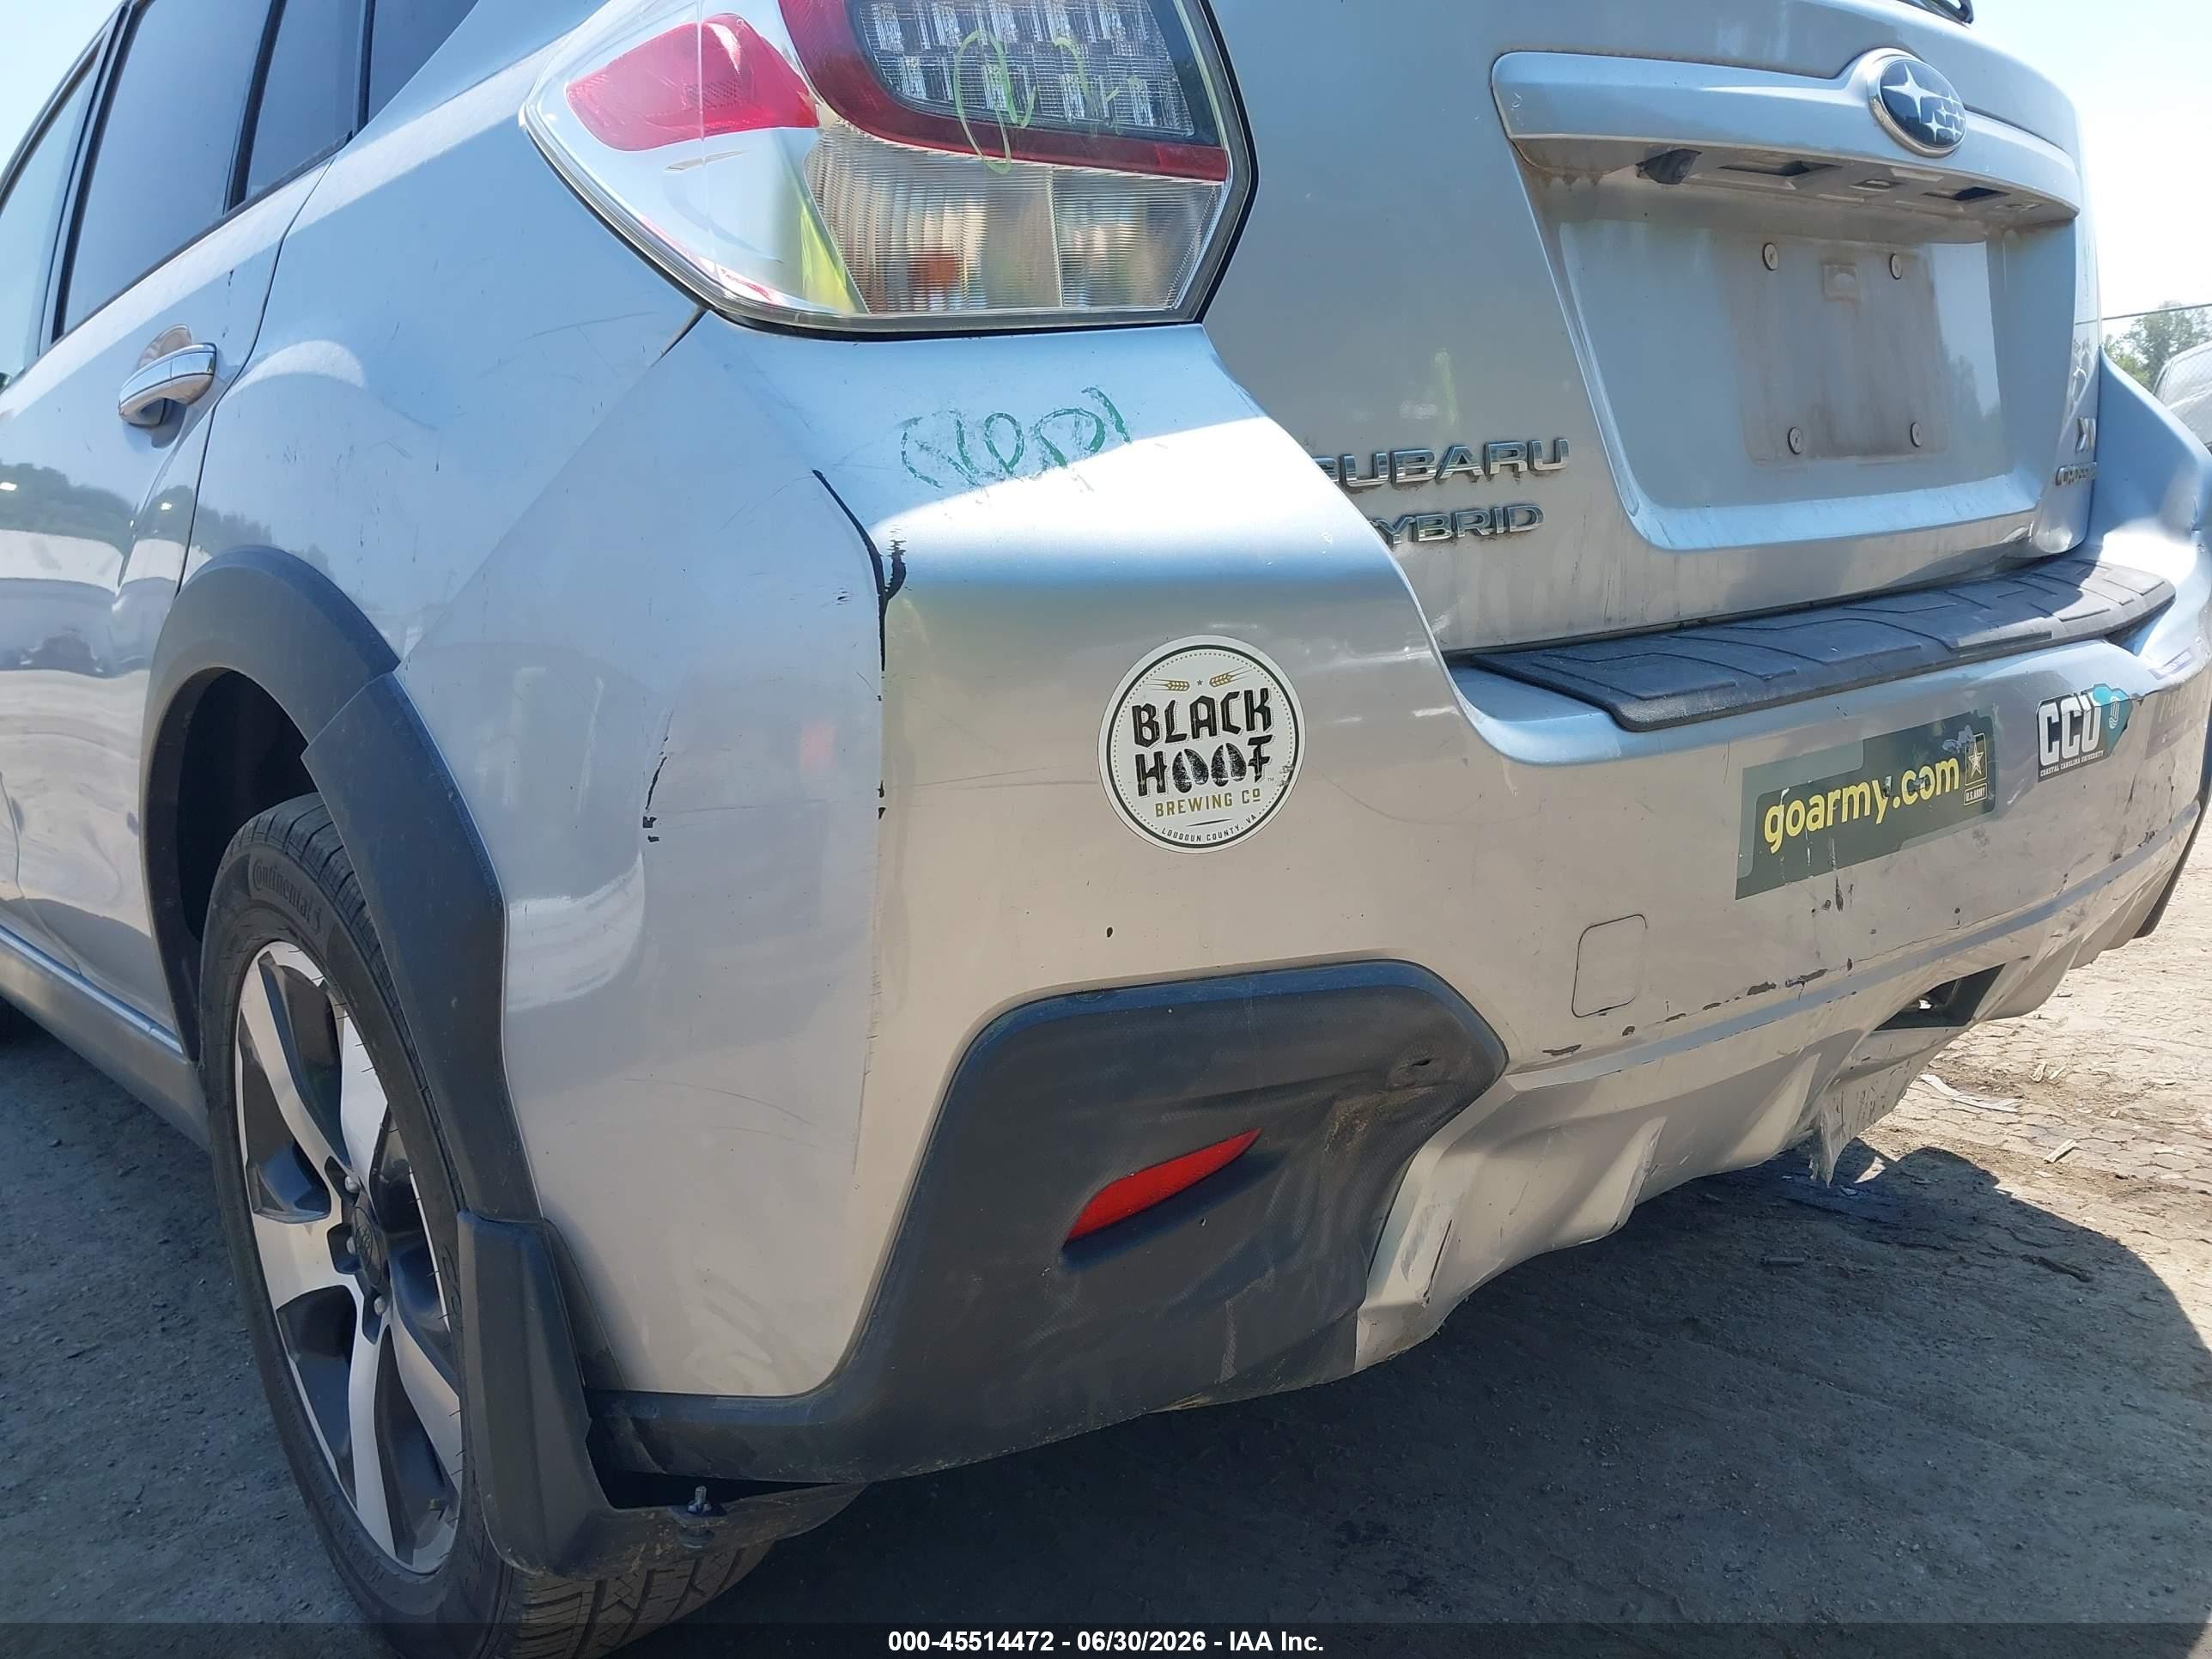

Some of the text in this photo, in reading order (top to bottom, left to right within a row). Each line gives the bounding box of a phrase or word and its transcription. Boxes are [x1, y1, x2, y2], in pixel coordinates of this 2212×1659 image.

[1131, 687, 1274, 749] BLACK
[2039, 692, 2102, 766] CCU
[2040, 750, 2104, 777] COASTAL CAROLINA UNIVERSITY
[1155, 793, 1233, 817] BREWING
[1764, 757, 1960, 854] goarmy.com
[1162, 827, 1201, 842] LOUDOUN
[1245, 814, 1257, 823] VA
